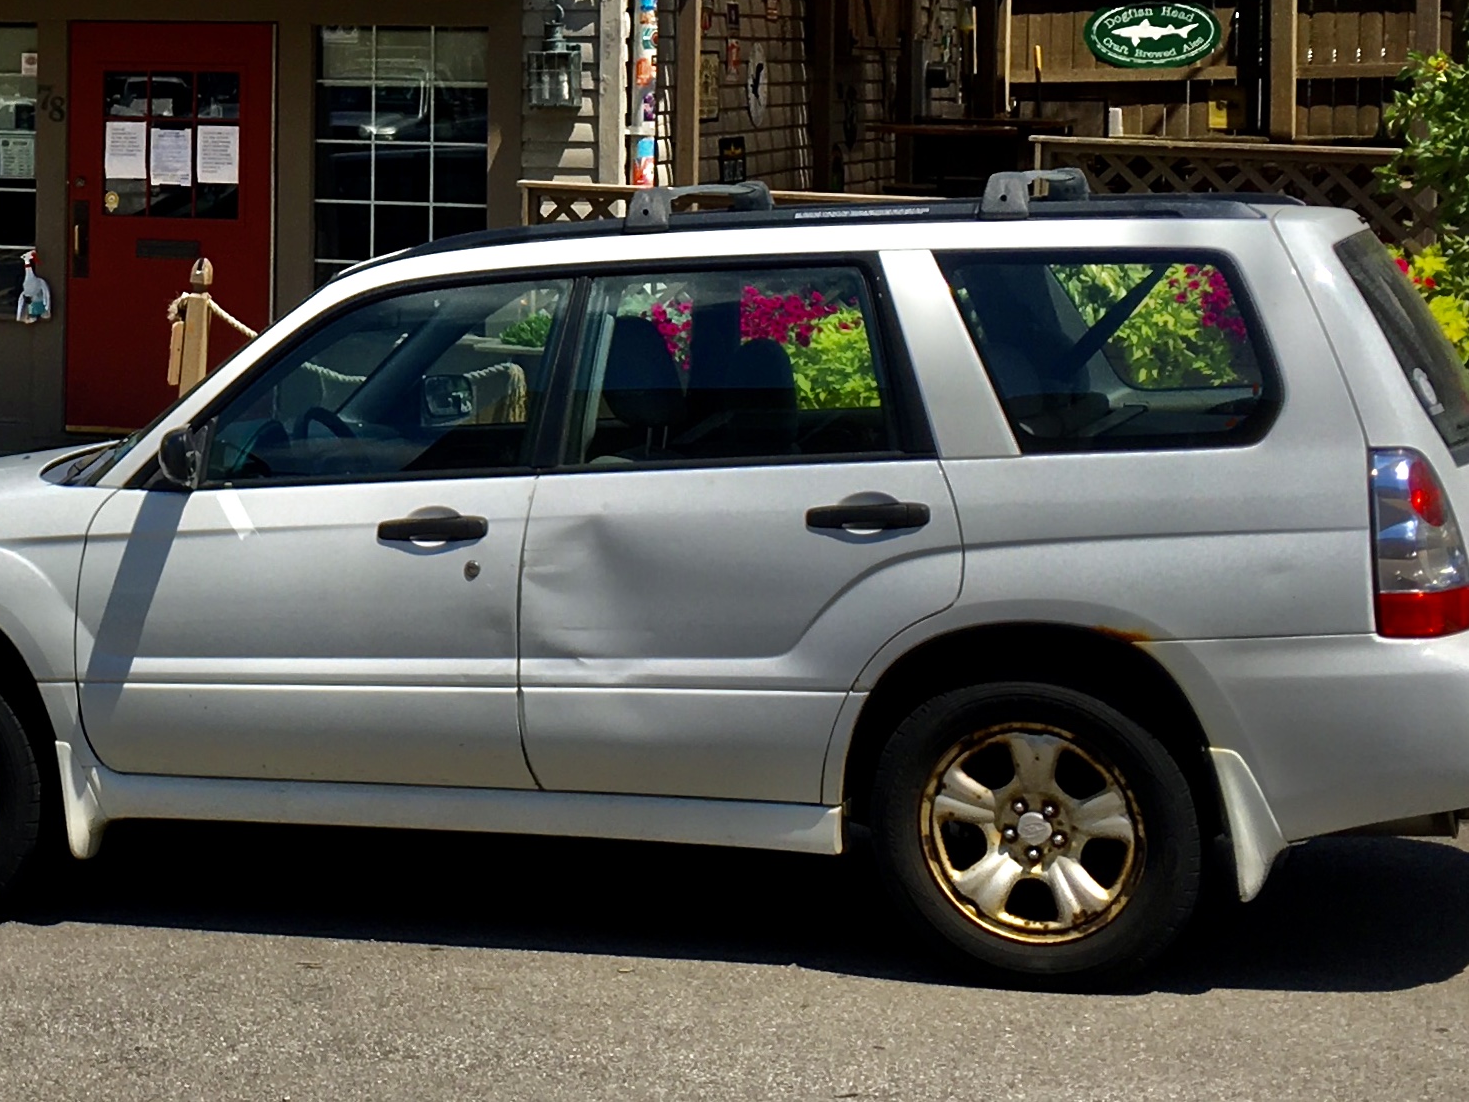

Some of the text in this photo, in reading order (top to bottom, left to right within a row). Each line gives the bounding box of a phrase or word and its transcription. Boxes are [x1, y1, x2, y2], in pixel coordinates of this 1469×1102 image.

[1103, 5, 1195, 29] Dogfish Head
[1102, 36, 1205, 59] Craft Brewed Ales
[38, 84, 65, 122] 78
